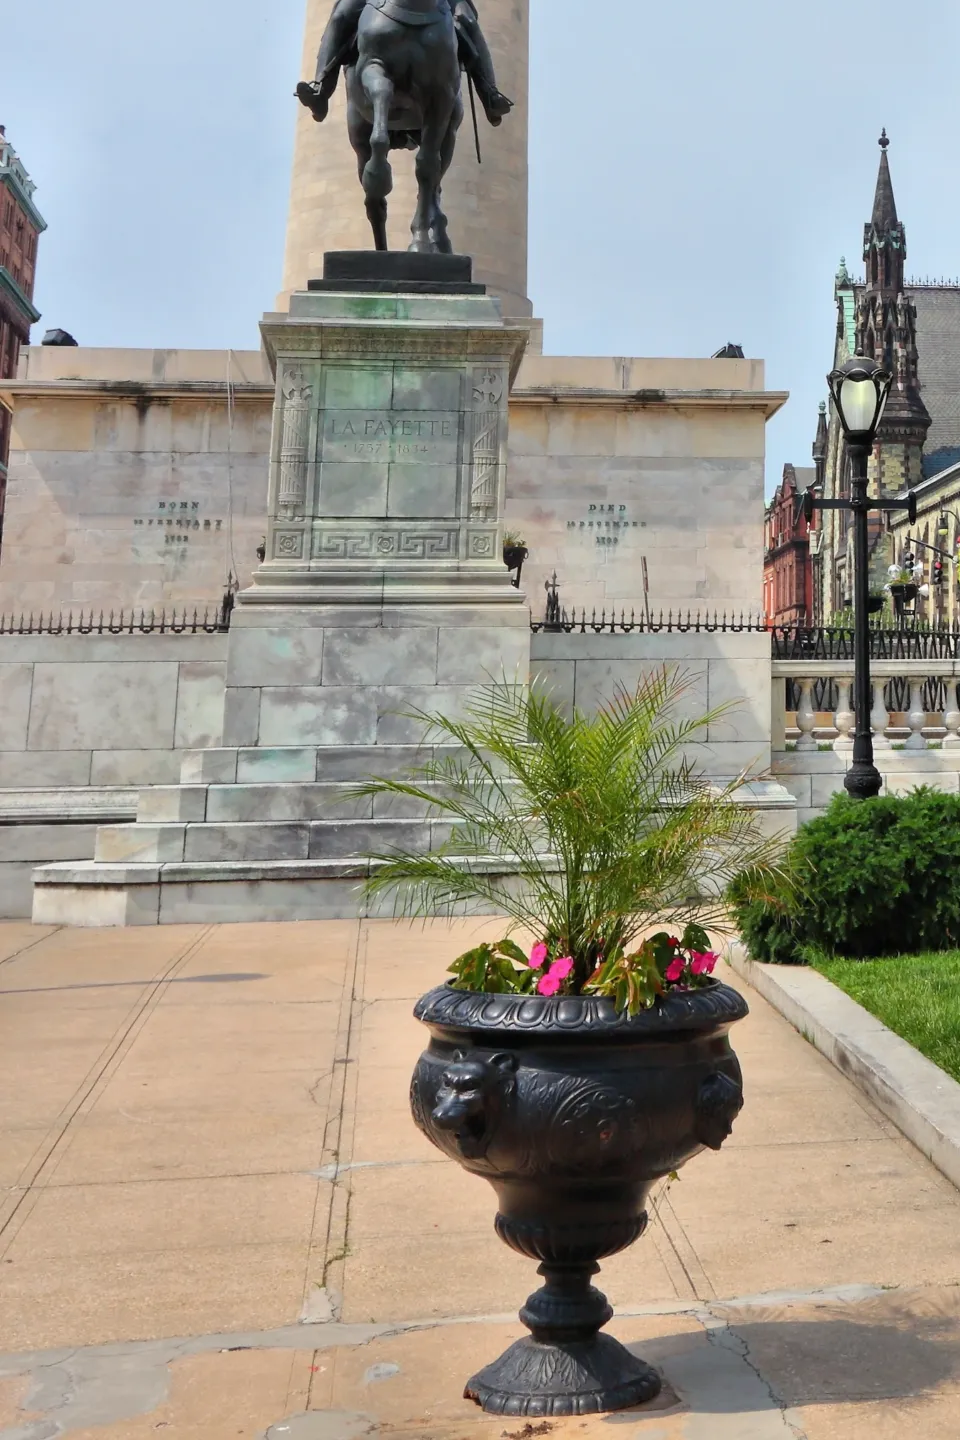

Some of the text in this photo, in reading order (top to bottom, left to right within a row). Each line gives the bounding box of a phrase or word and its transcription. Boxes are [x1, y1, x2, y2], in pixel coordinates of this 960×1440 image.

[331, 419, 452, 436] LA FAYETTE
[589, 504, 626, 512] DIED
